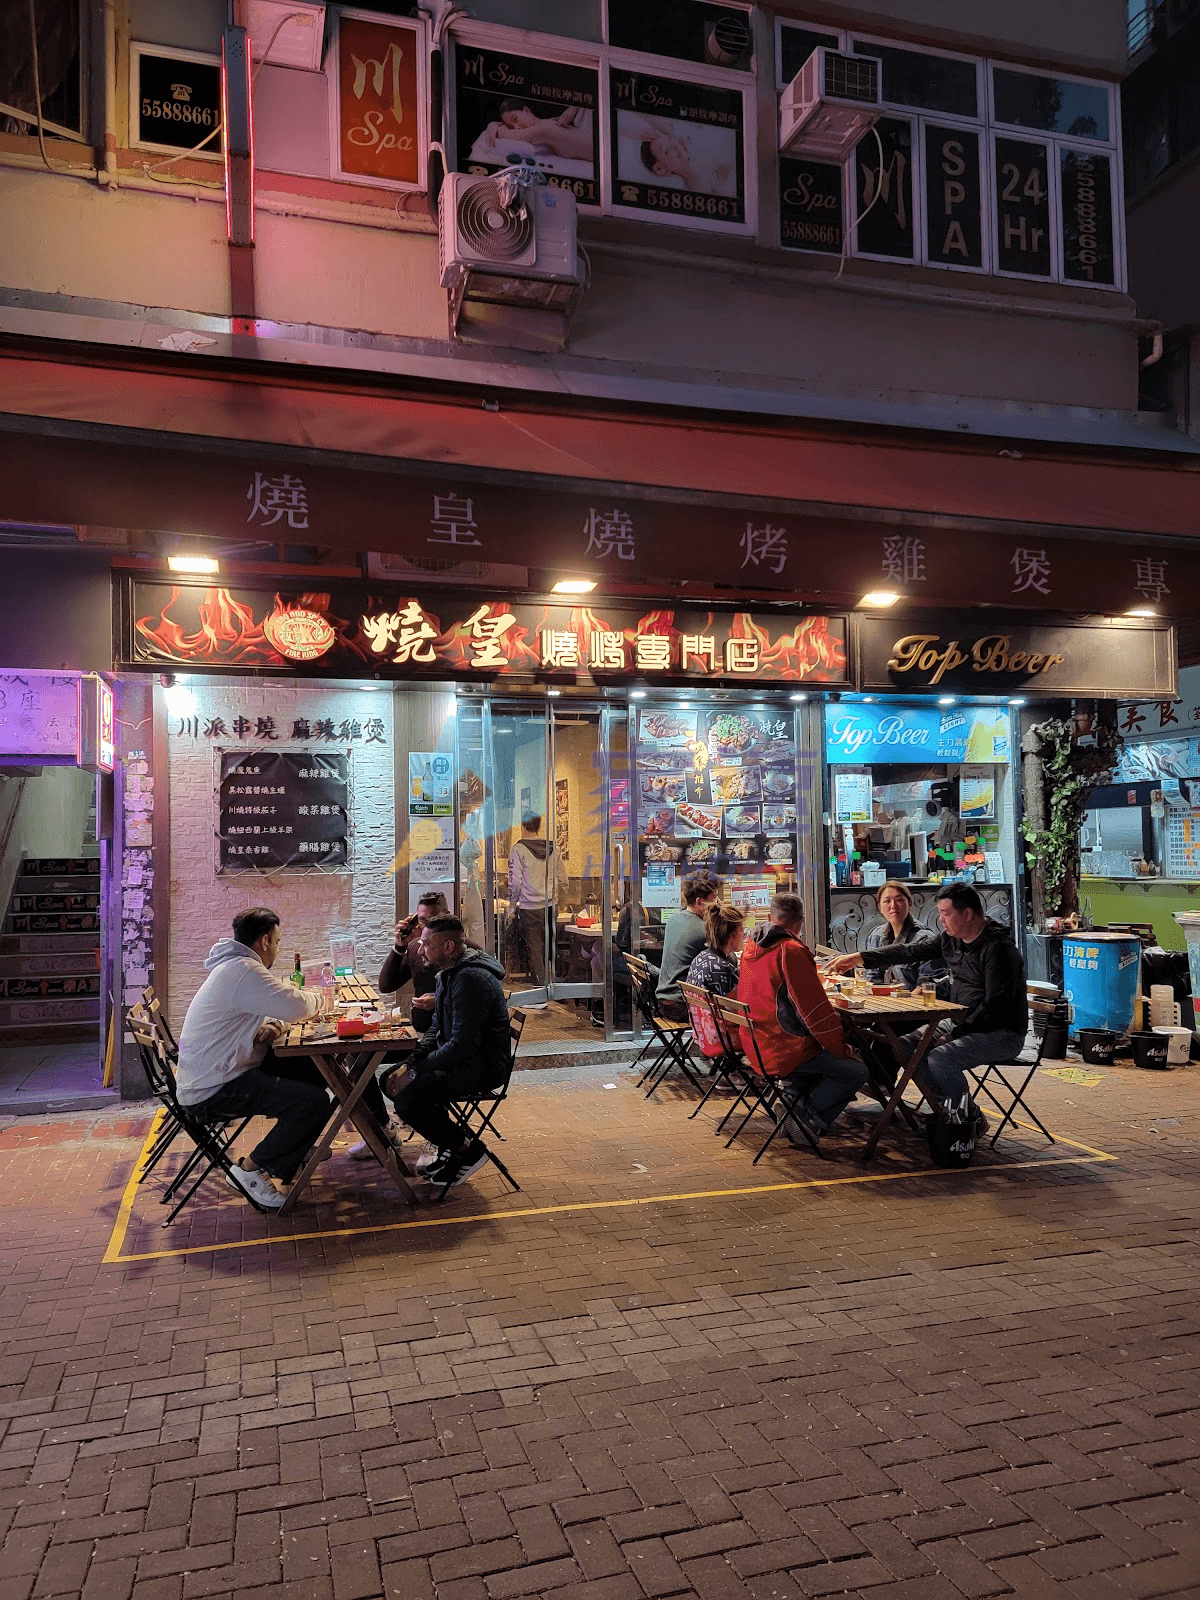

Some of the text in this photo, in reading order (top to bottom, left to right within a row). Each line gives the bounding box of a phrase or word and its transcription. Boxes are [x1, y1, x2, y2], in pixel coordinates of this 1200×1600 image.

[488, 62, 525, 86] Spa
[639, 85, 673, 107] Spa
[142, 97, 219, 127] 55888661
[346, 110, 413, 155] Spa
[783, 172, 838, 213] Spa
[941, 139, 970, 257] SPA
[1000, 162, 1043, 206] 24
[647, 188, 738, 217] 55888661
[783, 219, 841, 245] 55888661
[1003, 213, 1044, 253] Hr
[362, 601, 758, 672] 燒皇 燒烤專門店
[886, 634, 1065, 685] Top Beer
[177, 715, 387, 744] 川派串燒 麻辣雞煲
[828, 714, 931, 755] Top Beer
[42, 860, 67, 873] Spa
[38, 897, 65, 910] Spa
[32, 916, 59, 929] Spa
[9, 979, 40, 996] Spa
